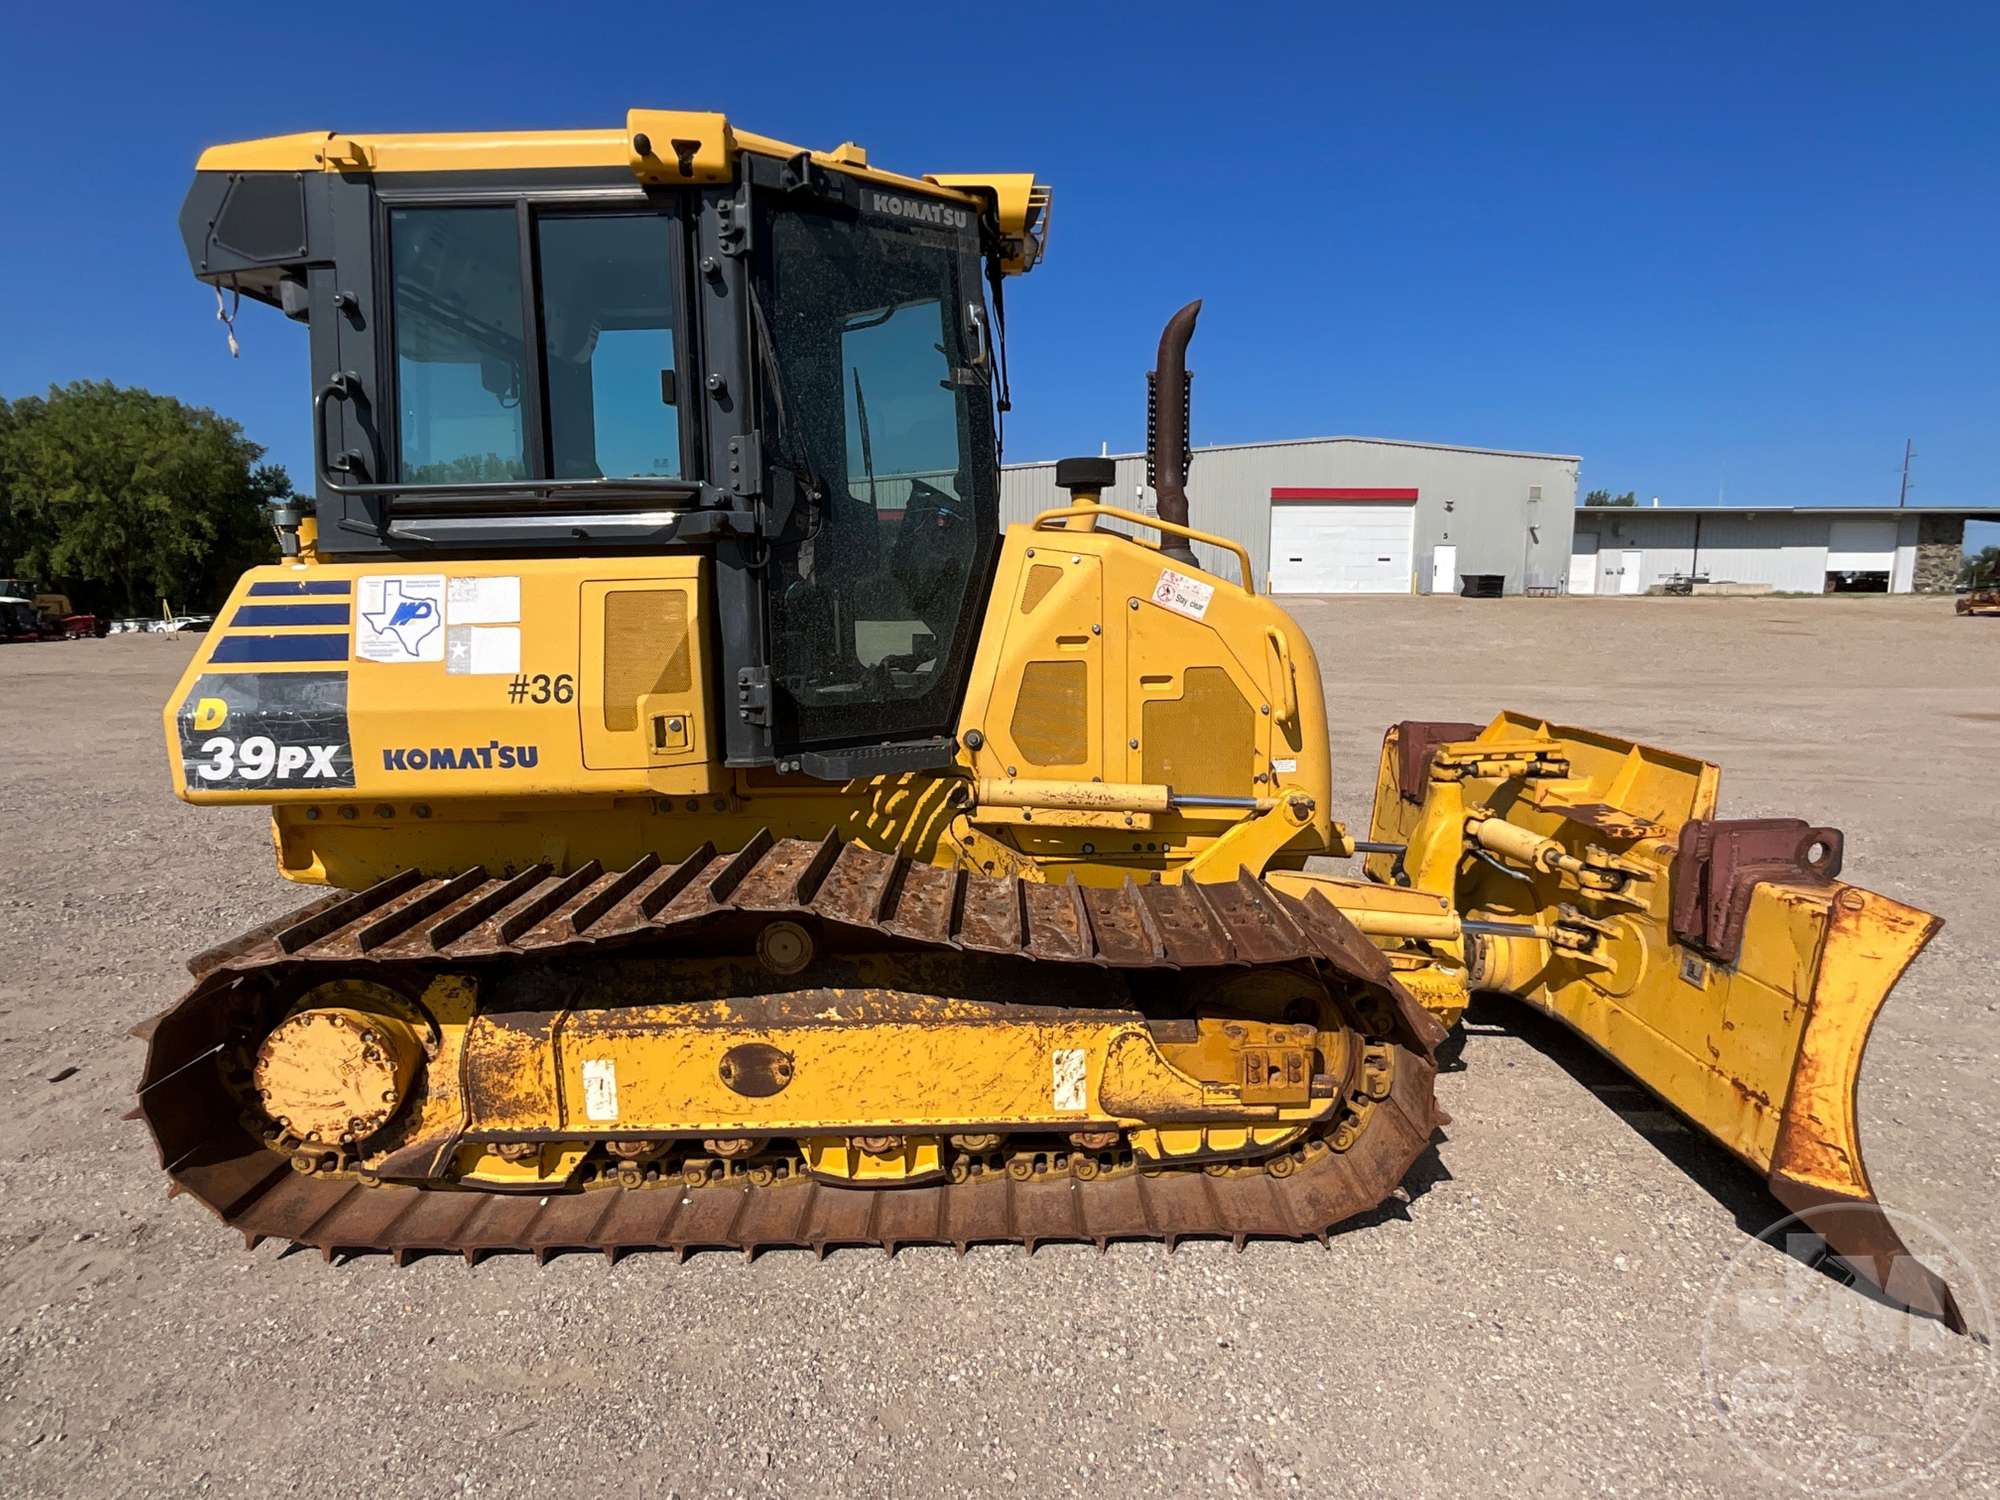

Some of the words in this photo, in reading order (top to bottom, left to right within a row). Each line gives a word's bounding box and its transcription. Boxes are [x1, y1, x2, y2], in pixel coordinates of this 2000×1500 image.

[873, 194, 967, 228] KOMATSU
[1175, 593, 1188, 607] Stay
[508, 674, 574, 704] #36
[194, 698, 228, 730] D
[197, 736, 340, 780] 39PX
[383, 740, 538, 770] KOMATSU
